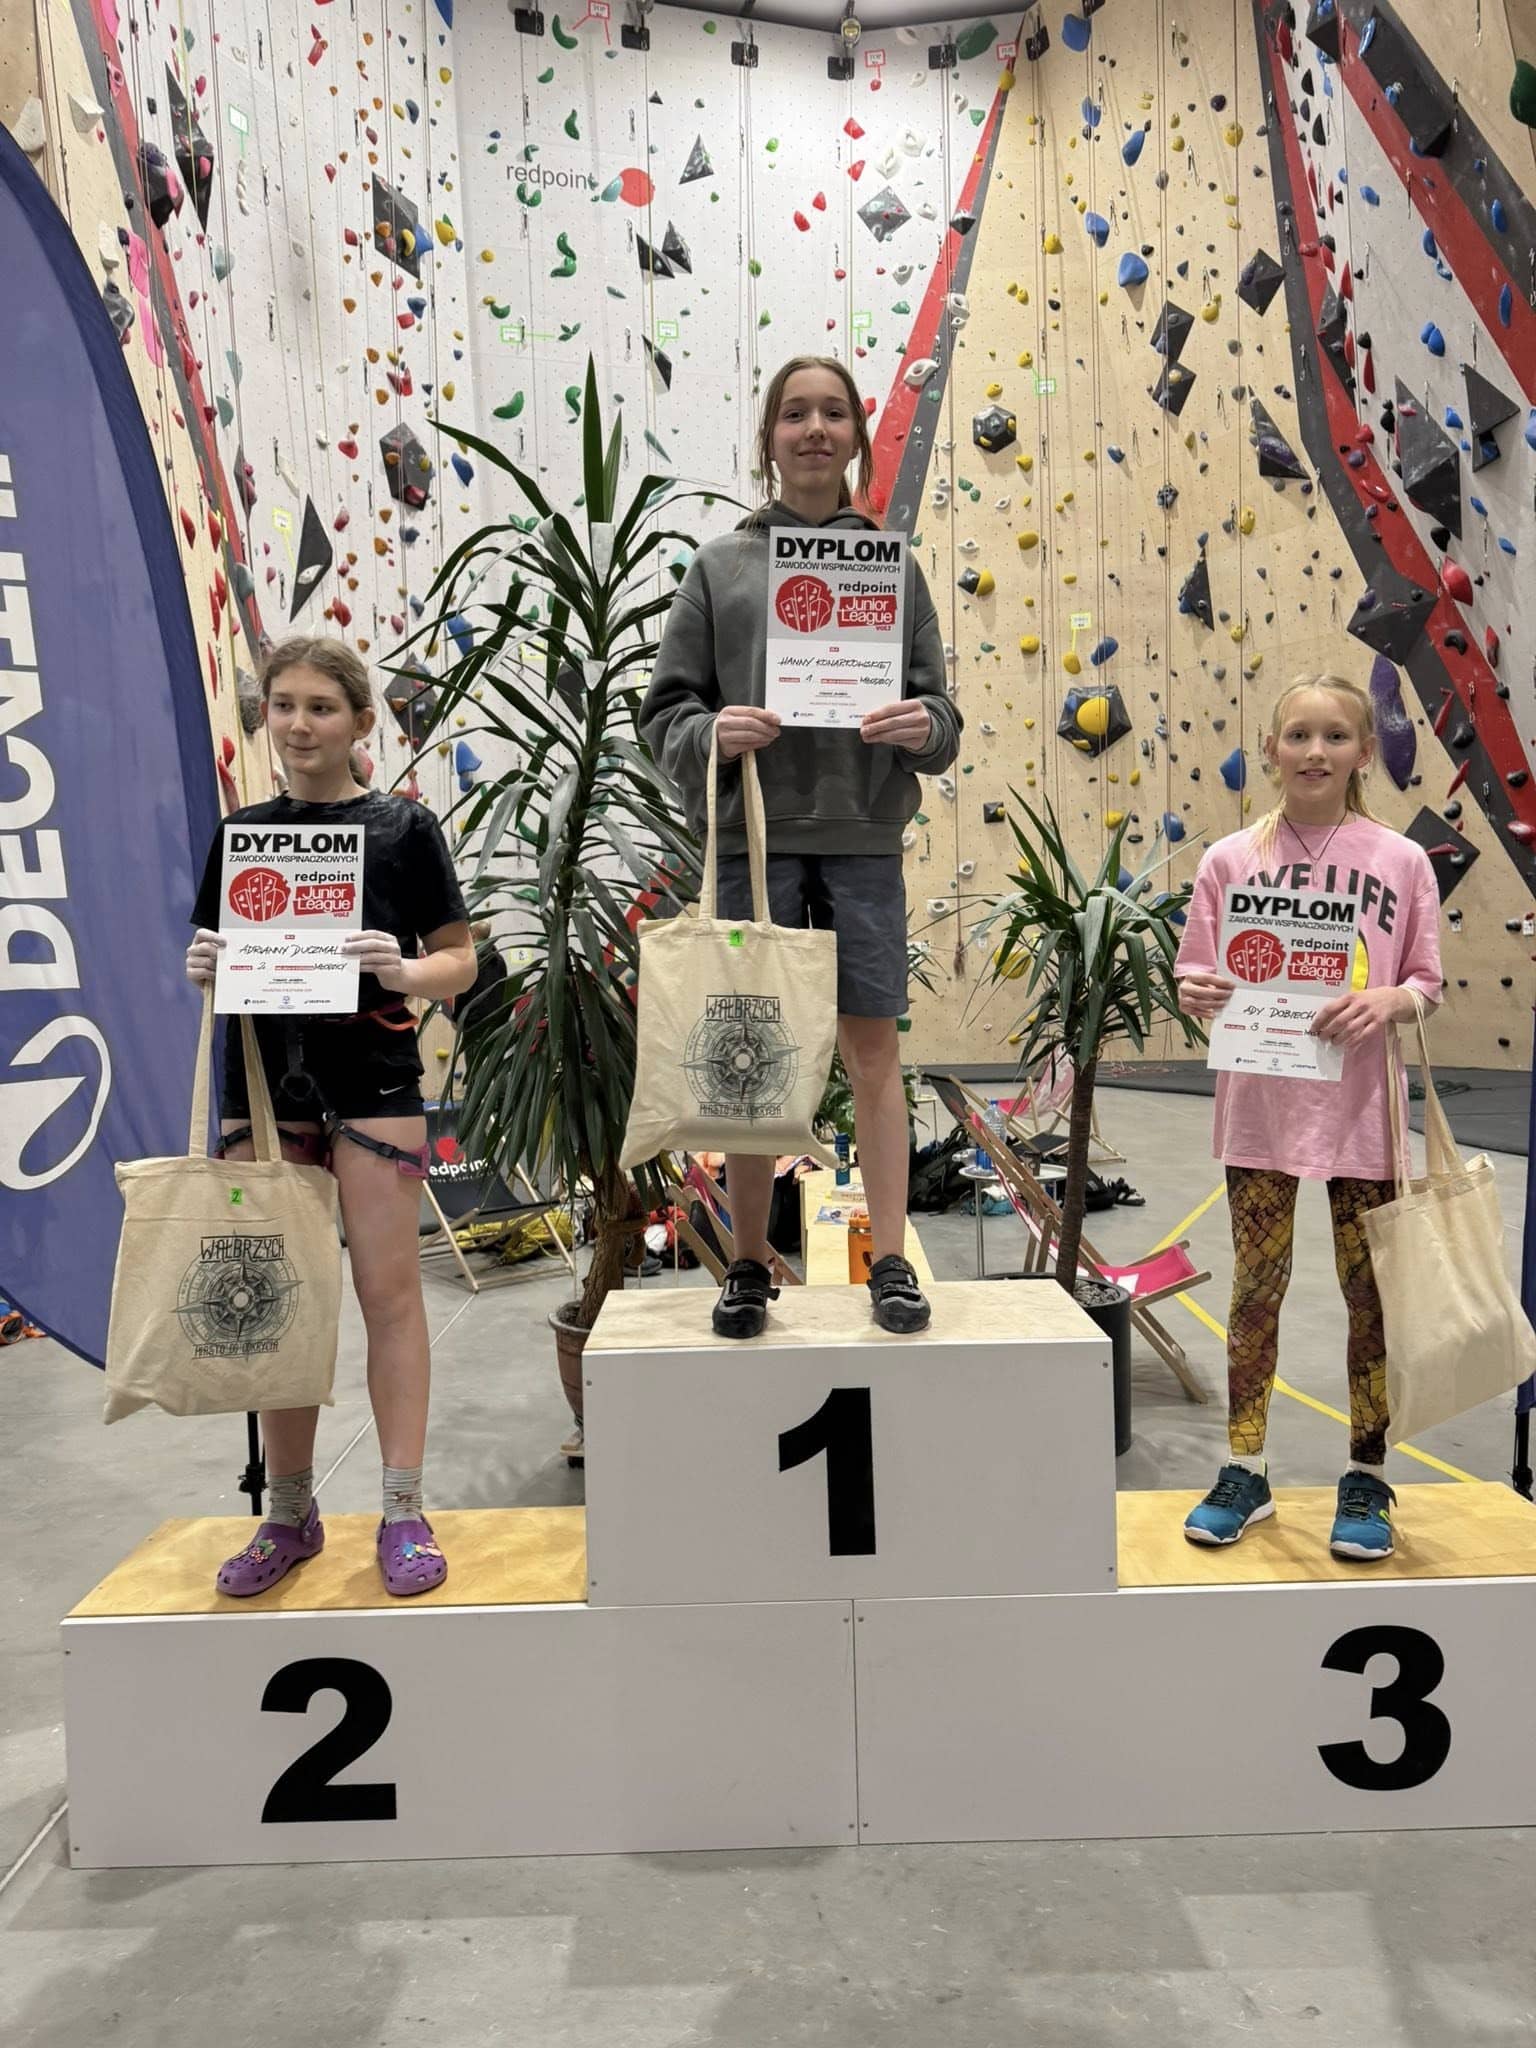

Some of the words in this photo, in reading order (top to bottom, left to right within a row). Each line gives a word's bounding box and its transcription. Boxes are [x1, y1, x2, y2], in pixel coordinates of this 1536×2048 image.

[775, 536, 900, 563] DYPLOM
[775, 560, 820, 571] ZAWODÓW
[821, 562, 901, 573] WSPINACZKOWYCH
[838, 581, 897, 594] redpoint
[845, 597, 888, 611] Junior
[841, 608, 892, 626] League
[230, 833, 358, 853] DYPLOM
[229, 854, 275, 863] ZAWODÓW
[276, 855, 359, 863] WSPINACZKOWYCH
[295, 871, 356, 883] redpoint
[302, 886, 346, 899] Junior
[297, 897, 351, 912] League
[1230, 893, 1355, 923] DYPLOM
[1228, 915, 1274, 926] ZAWODÓW
[1274, 918, 1354, 932] WSPINACZKOWYCH
[1291, 937, 1350, 951] redpoint
[1296, 952, 1342, 967] Junior
[1291, 963, 1343, 980] League
[705, 998, 781, 1023] WAŁBRZYCH
[1243, 1005, 1265, 1016] ADY
[1250, 1022, 1259, 1031] 3
[231, 1189, 241, 1203] 2
[200, 1238, 285, 1263] WAŁBRZYCH
[779, 1387, 876, 1556] 1
[1318, 1625, 1451, 1791] 3
[261, 1658, 397, 1823] 2
